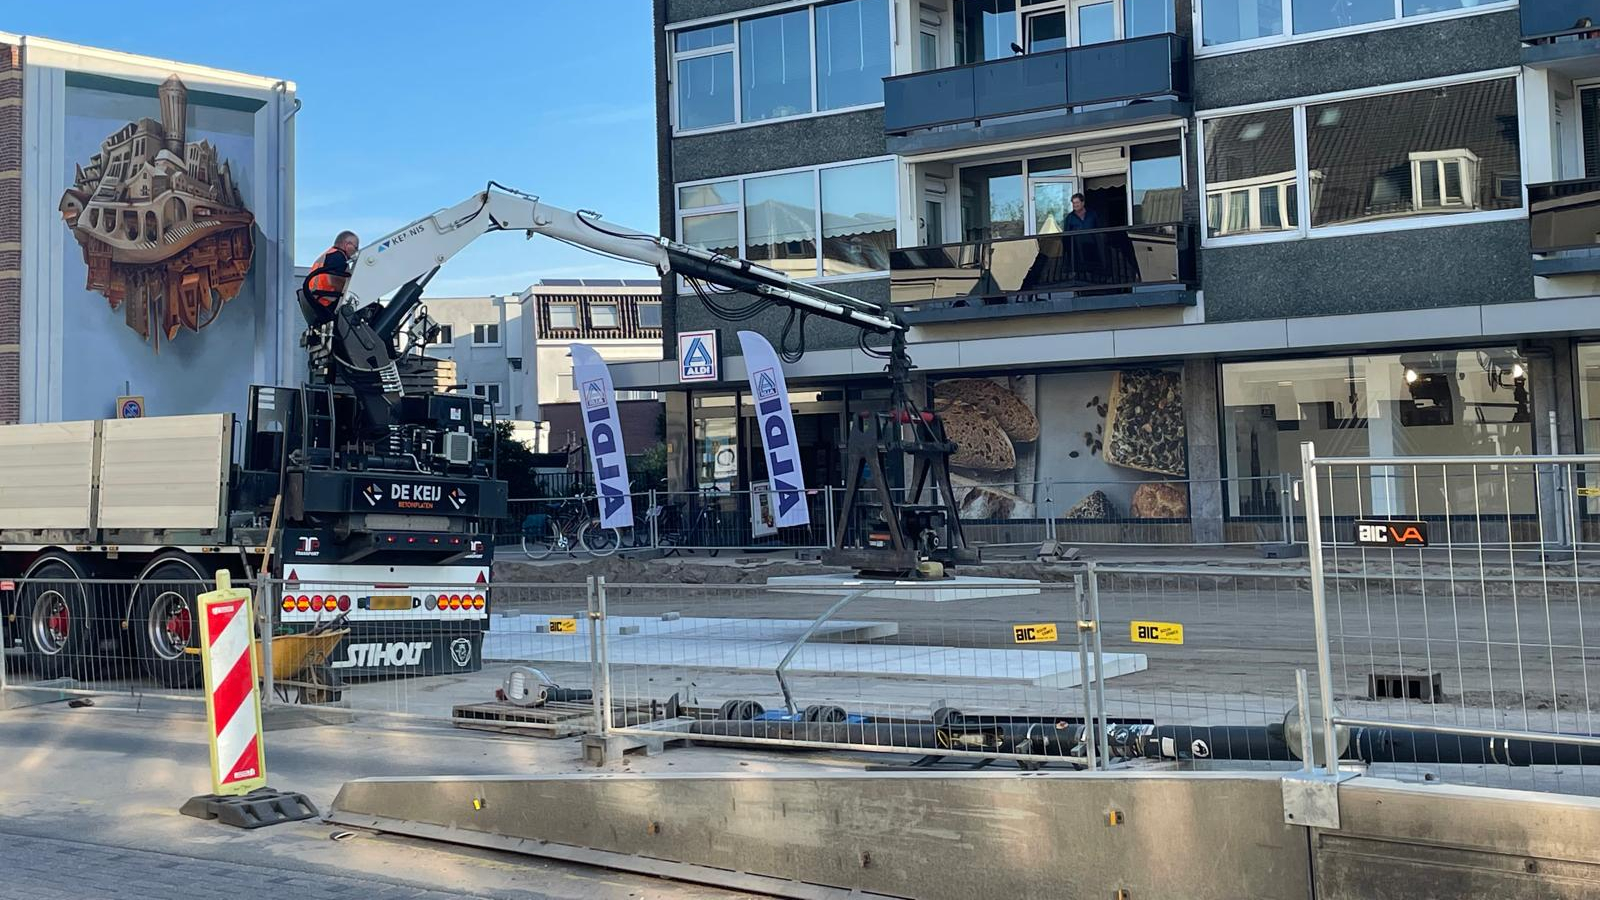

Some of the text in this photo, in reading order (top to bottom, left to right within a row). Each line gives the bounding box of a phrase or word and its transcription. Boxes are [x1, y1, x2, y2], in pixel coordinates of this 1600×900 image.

[686, 366, 711, 376] ALDI
[391, 483, 441, 502] DE KEIJ
[331, 641, 432, 668] STIHOLT
